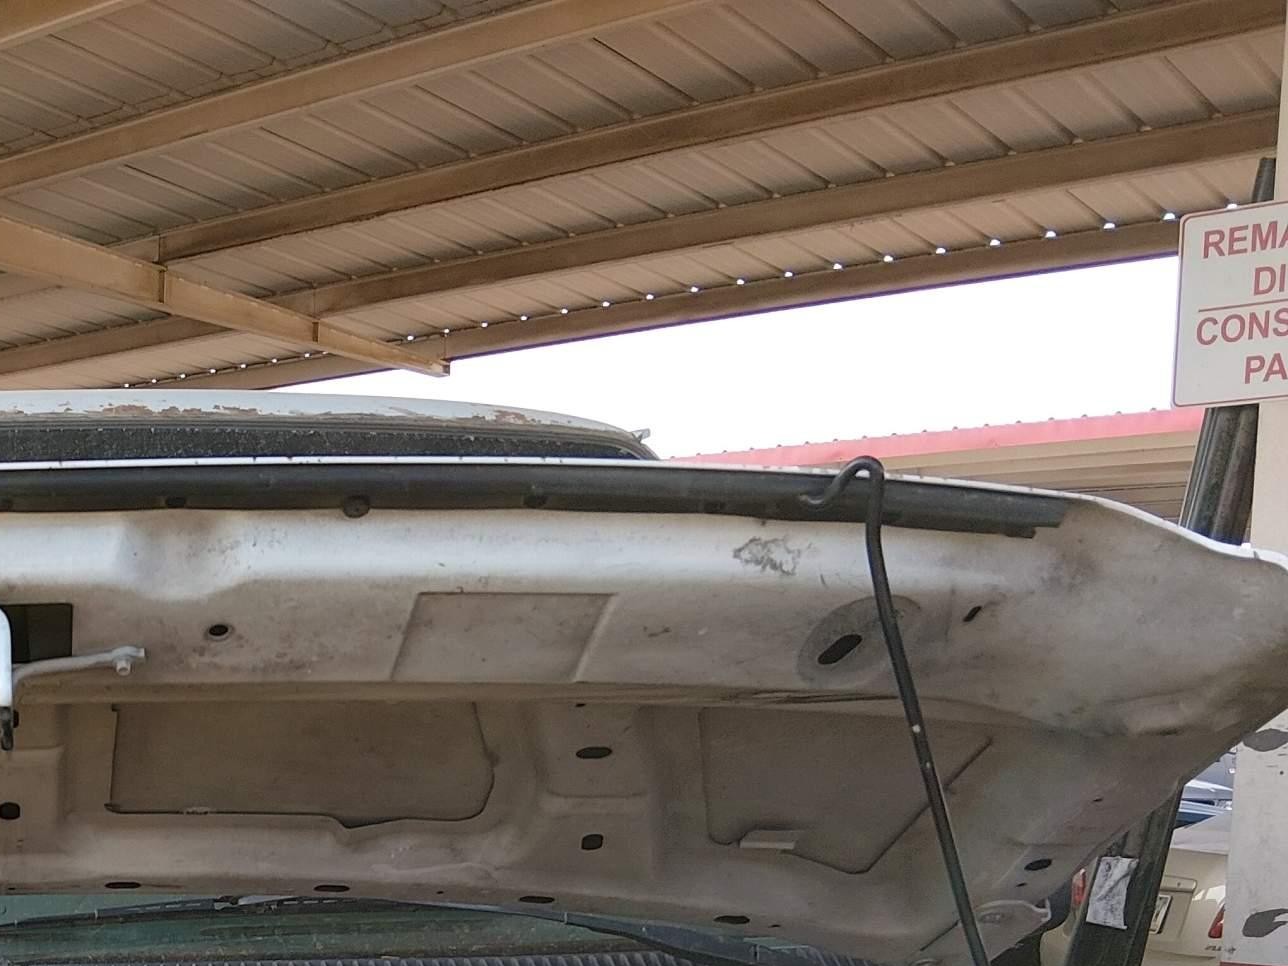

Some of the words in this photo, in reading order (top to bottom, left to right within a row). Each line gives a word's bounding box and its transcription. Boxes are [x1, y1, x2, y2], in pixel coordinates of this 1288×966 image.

[1253, 264, 1287, 296] DI
[1196, 308, 1288, 346] CONS
[1244, 353, 1288, 384] PA
